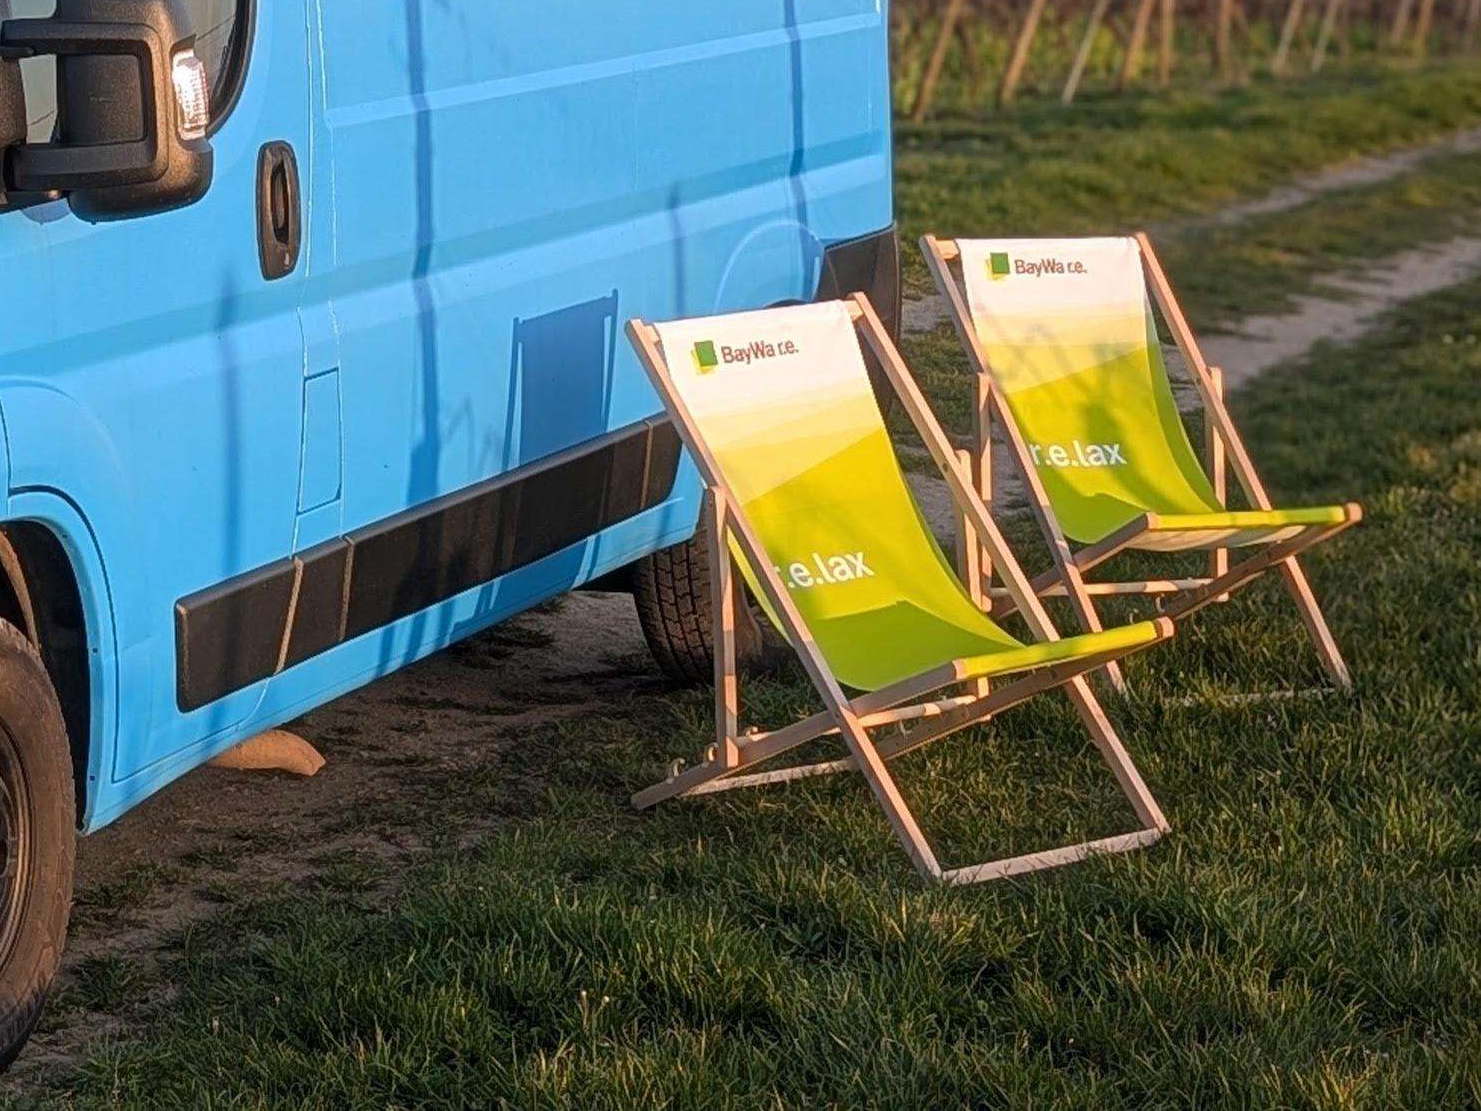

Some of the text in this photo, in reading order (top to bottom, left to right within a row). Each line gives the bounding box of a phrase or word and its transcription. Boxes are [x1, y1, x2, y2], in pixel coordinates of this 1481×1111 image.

[1014, 258, 1065, 278] BayWa
[721, 340, 799, 365] BayWa r.e.
[1029, 440, 1127, 467] r.e.lax
